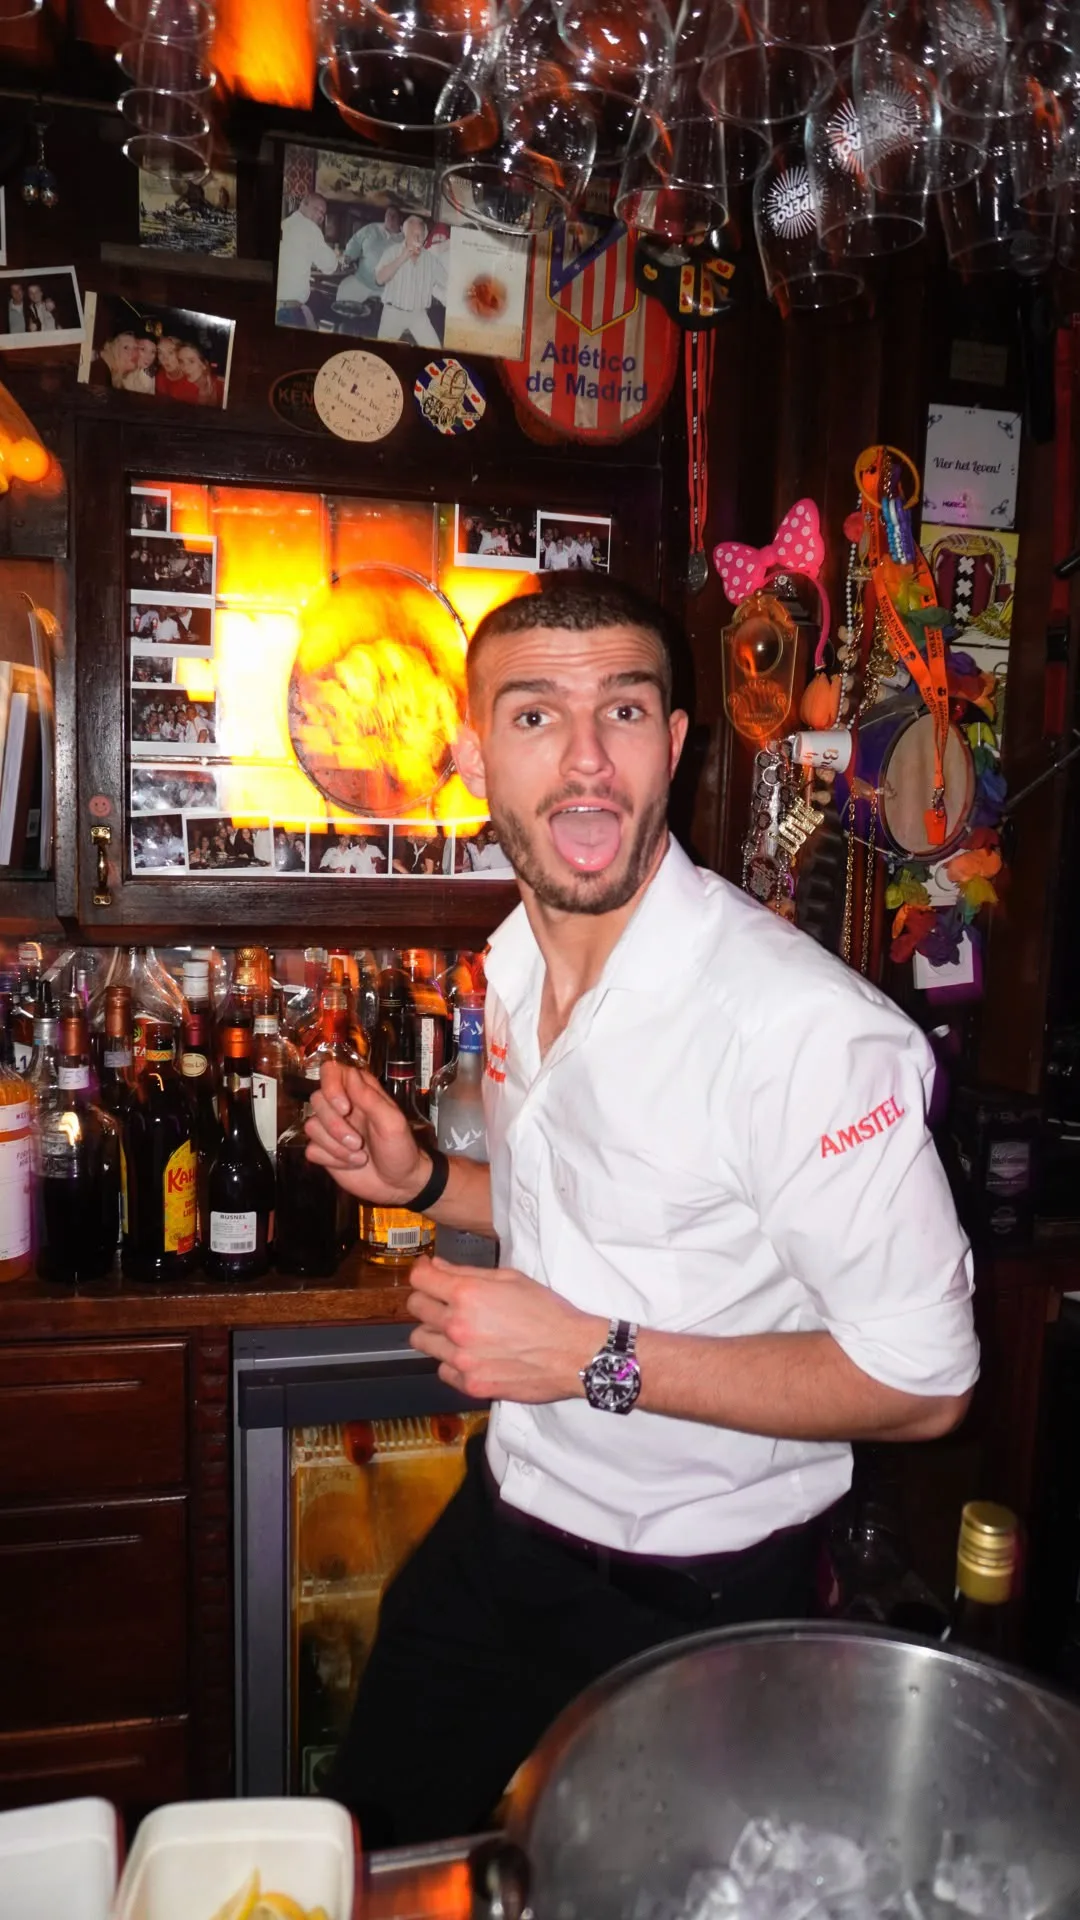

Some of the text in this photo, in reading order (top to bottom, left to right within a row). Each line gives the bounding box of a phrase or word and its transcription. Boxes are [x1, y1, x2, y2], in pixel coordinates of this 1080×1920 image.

[540, 340, 637, 372] Atlético
[278, 388, 314, 405] KEN
[526, 371, 648, 403] de Madrid
[933, 457, 1002, 475] Vier het Leven!
[819, 1095, 905, 1158] AMSTEL
